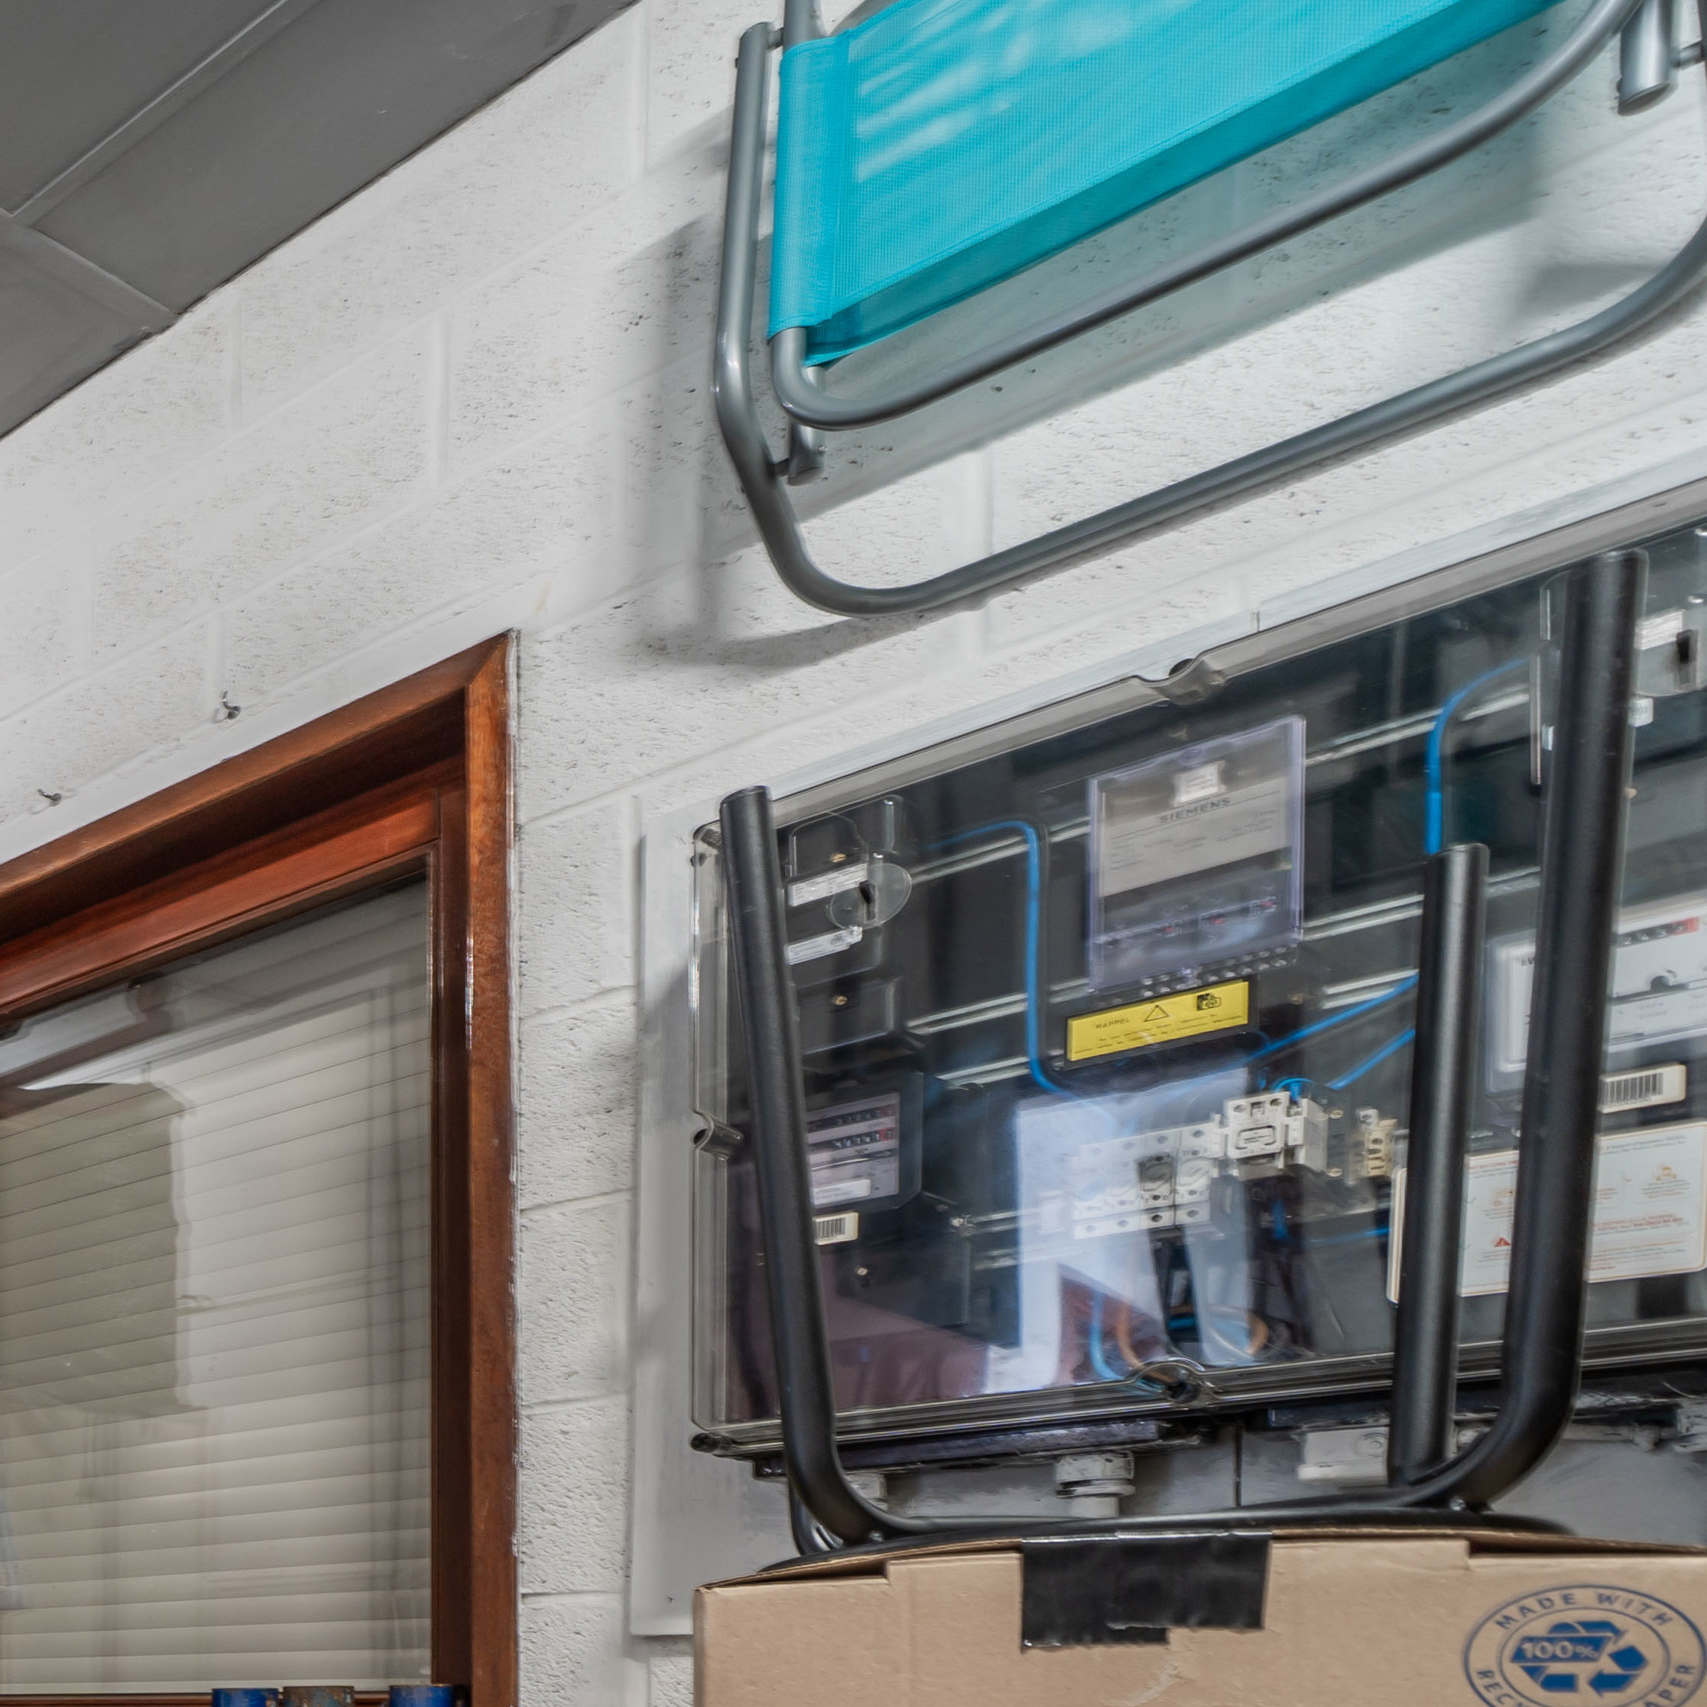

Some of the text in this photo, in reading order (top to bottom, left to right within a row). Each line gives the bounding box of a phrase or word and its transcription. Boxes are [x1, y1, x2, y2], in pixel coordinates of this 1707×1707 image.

[1159, 797, 1231, 824] SIEMENS
[1495, 1592, 1674, 1630] MADE WITH
[1520, 1641, 1600, 1660] 100%
